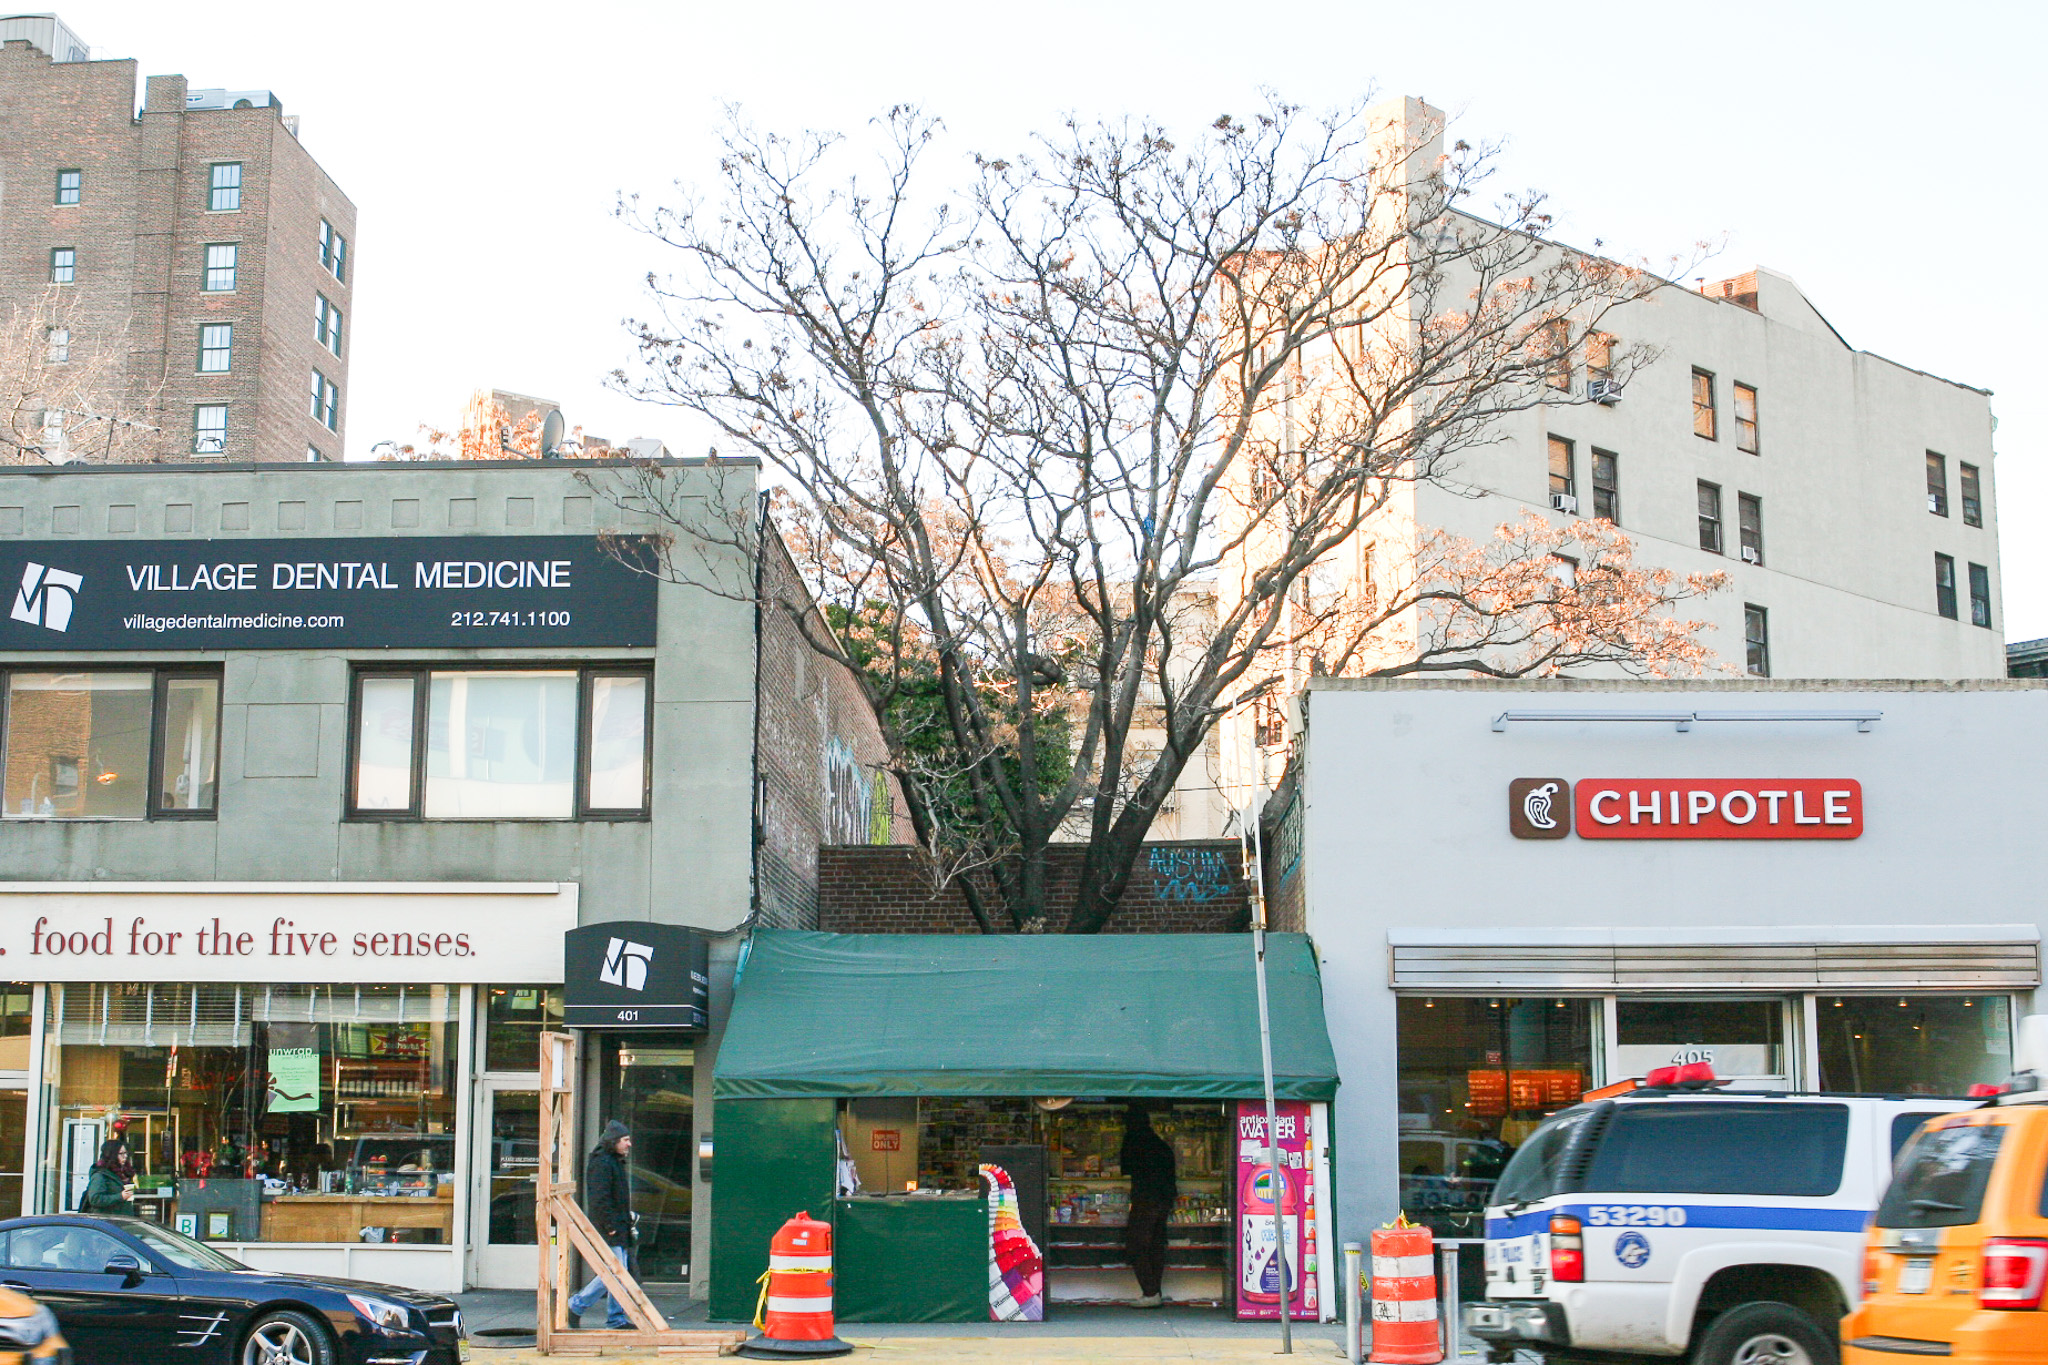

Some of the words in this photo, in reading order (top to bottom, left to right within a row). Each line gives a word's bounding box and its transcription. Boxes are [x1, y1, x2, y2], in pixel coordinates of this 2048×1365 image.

[126, 563, 258, 591] VILLAGE
[272, 562, 399, 590] DENTAL
[415, 560, 572, 589] MEDICINE
[123, 611, 345, 632] villagedentalmedicine.com
[450, 610, 571, 627] 212.741.1100
[1589, 789, 1853, 826] CHIPOTLE
[30, 916, 113, 956] food
[128, 916, 183, 956] for
[196, 917, 254, 956] the
[268, 916, 338, 956] five
[352, 932, 476, 957] senses.
[617, 1010, 639, 1021] 401
[269, 1047, 312, 1056] unwrap
[1671, 1049, 1715, 1066] 405
[1240, 1123, 1295, 1138] WAER
[873, 1140, 899, 1149] ONLY
[1588, 1206, 1687, 1226] 53290
[181, 1219, 192, 1233] B
